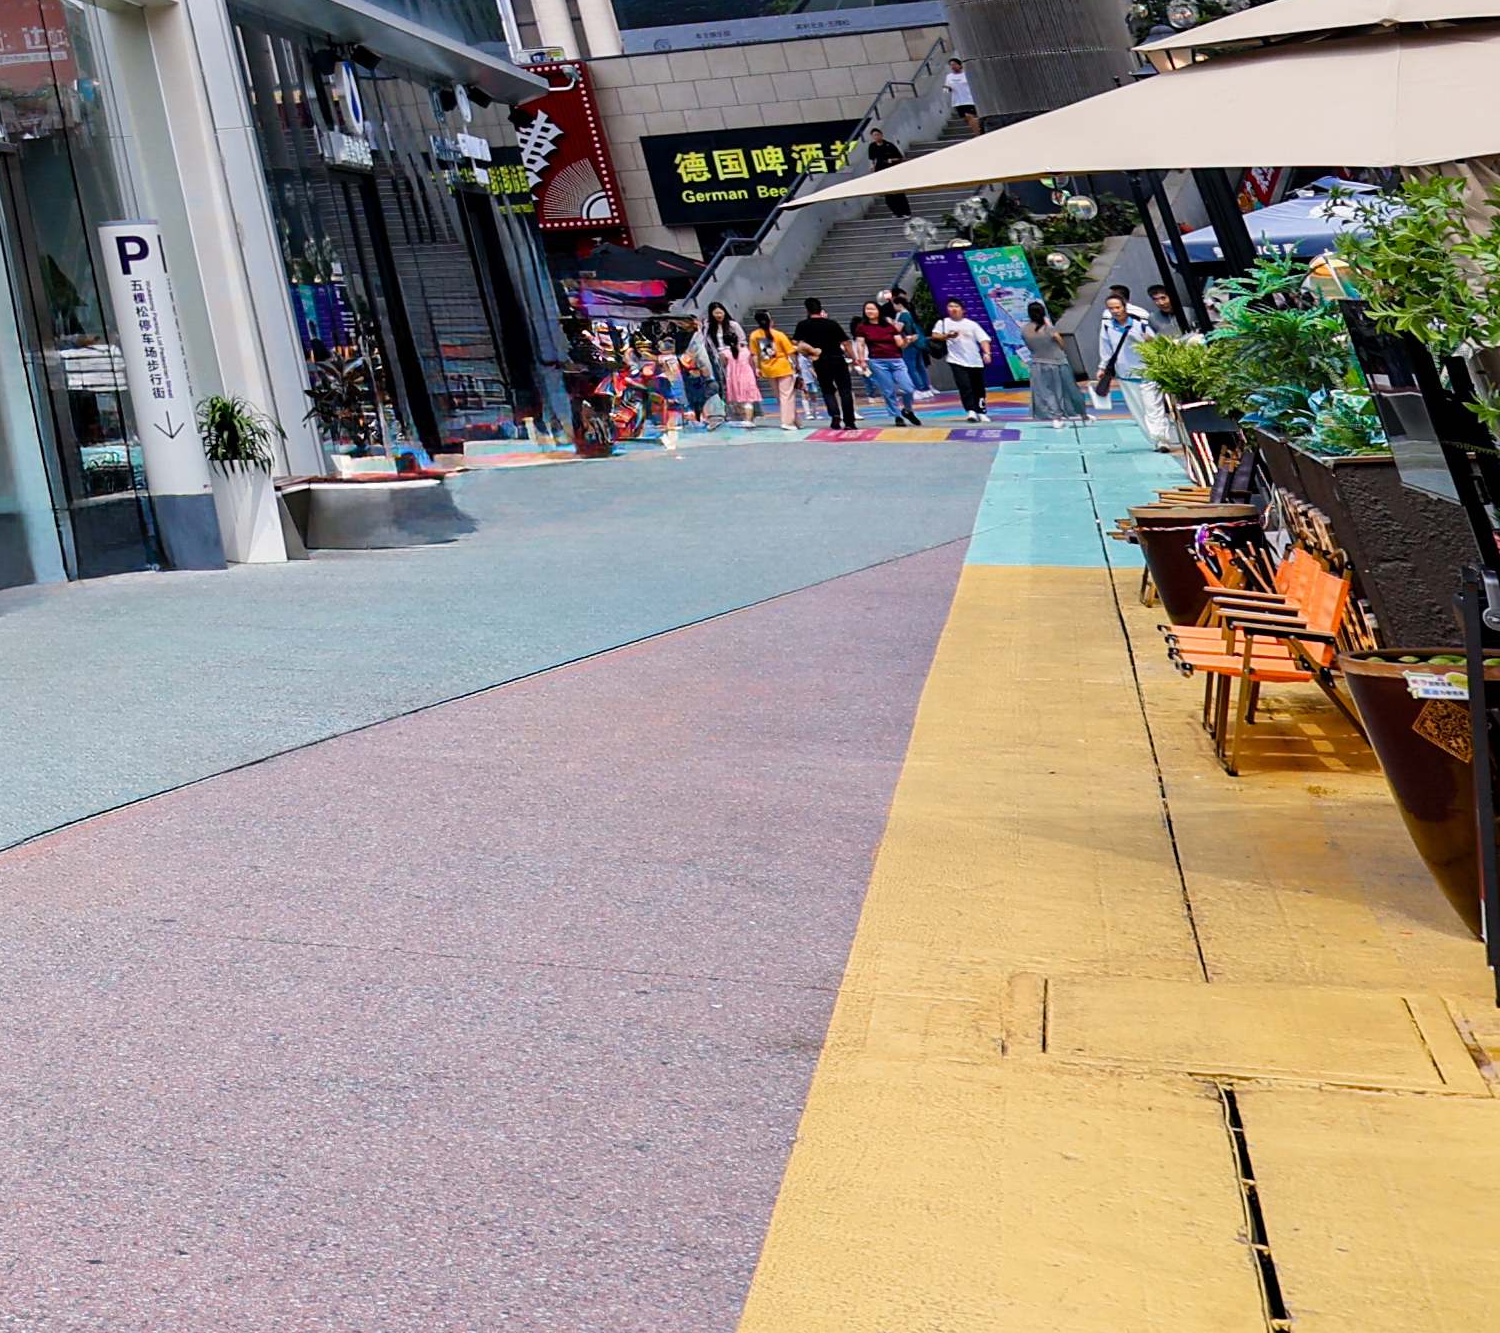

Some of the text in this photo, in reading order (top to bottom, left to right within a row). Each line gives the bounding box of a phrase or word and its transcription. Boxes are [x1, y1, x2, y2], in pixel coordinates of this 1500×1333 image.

[681, 185, 789, 203] German Bee
[115, 236, 149, 275] P
[130, 279, 166, 399] 五棵松停车场步行街
